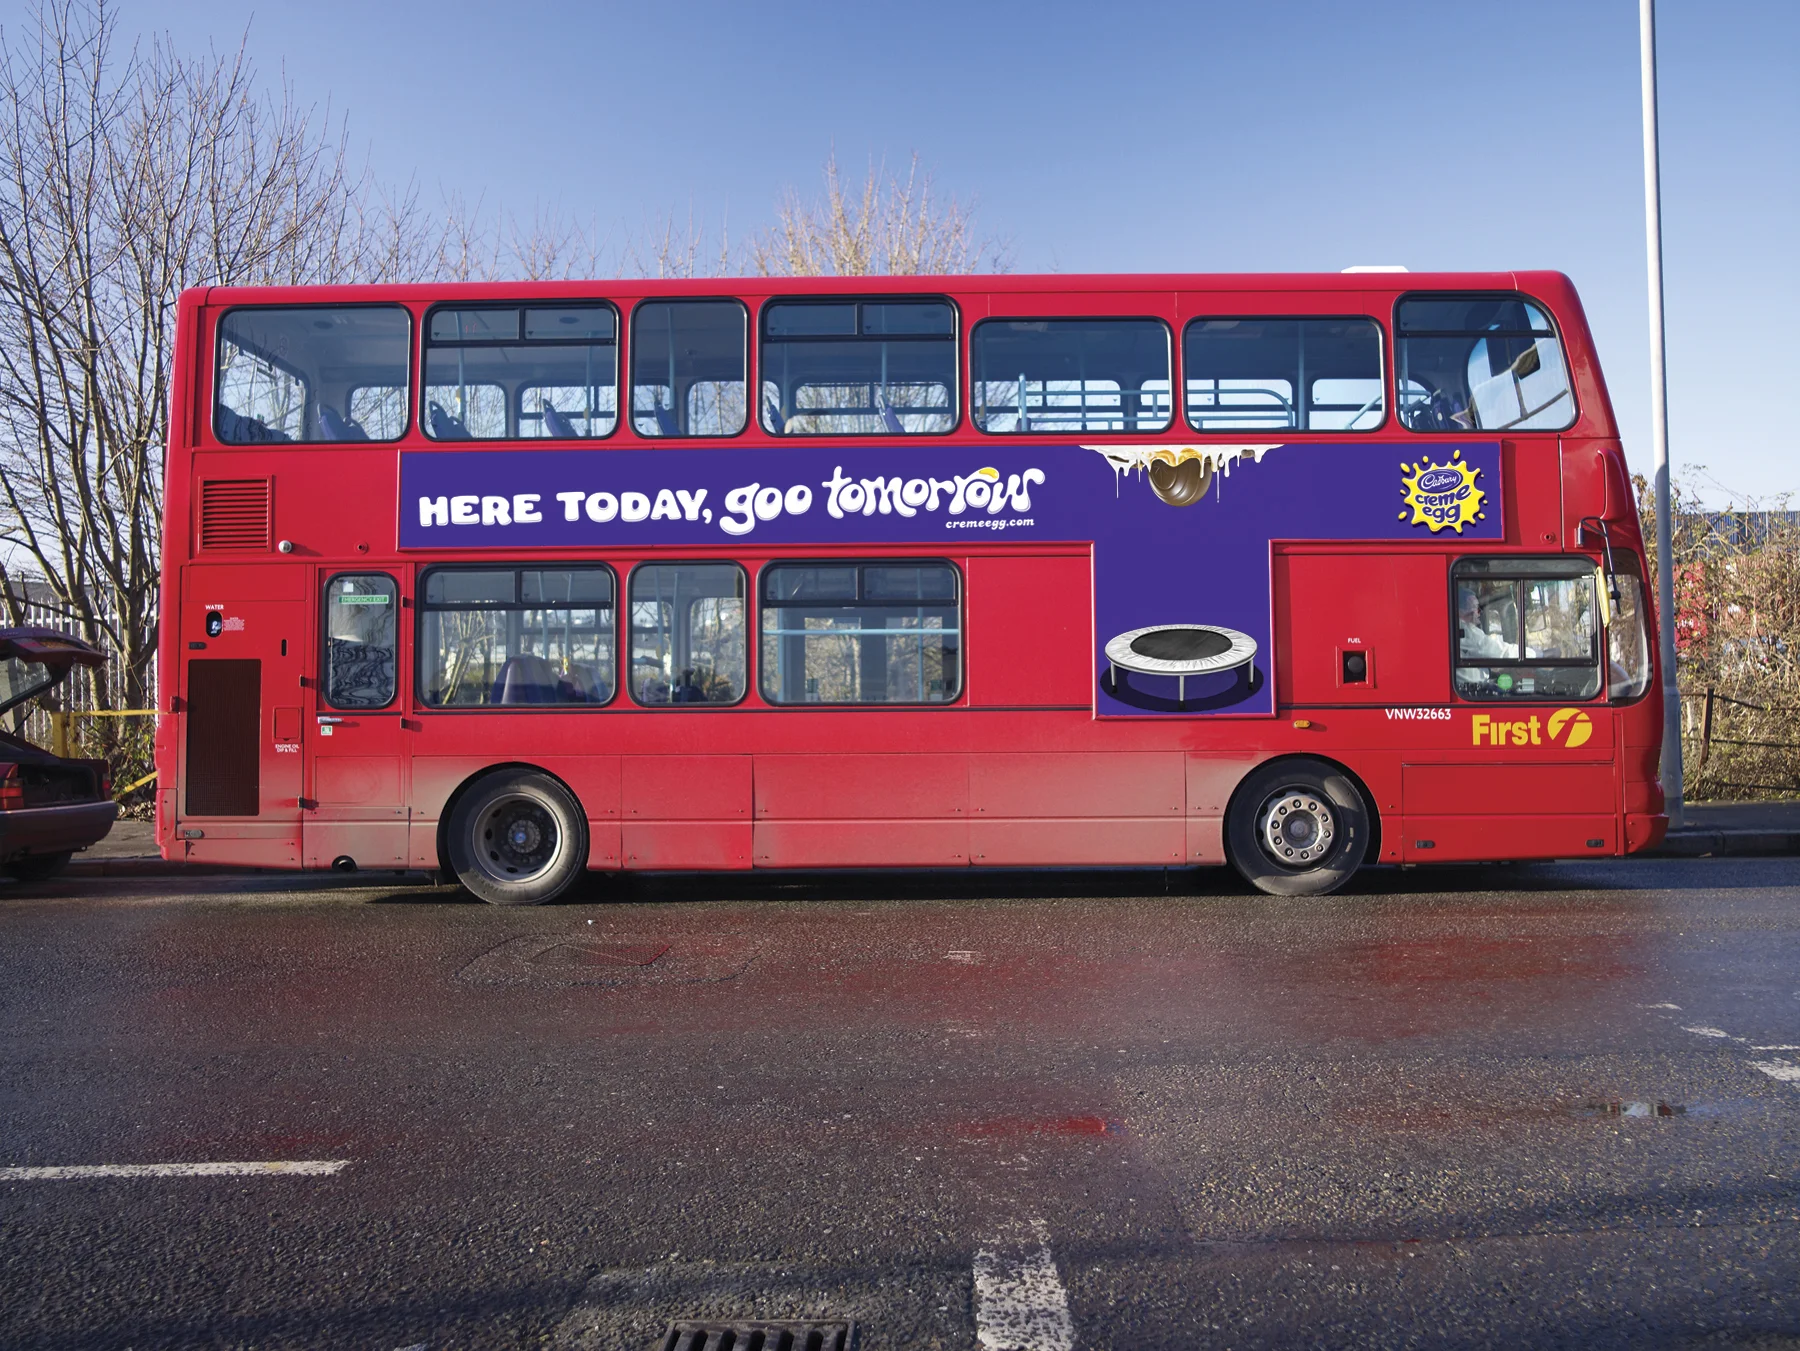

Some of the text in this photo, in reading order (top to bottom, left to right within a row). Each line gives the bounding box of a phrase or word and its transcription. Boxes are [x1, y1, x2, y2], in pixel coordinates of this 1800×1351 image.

[1420, 474, 1457, 489] Cadbury
[419, 466, 1045, 536] HERE TODAY, goo tomorrow
[1414, 484, 1471, 506] creme
[1422, 503, 1461, 524] egg
[945, 518, 1035, 531] cremeegg.com
[1385, 708, 1452, 720] VNW32663
[1472, 714, 1542, 746] First
